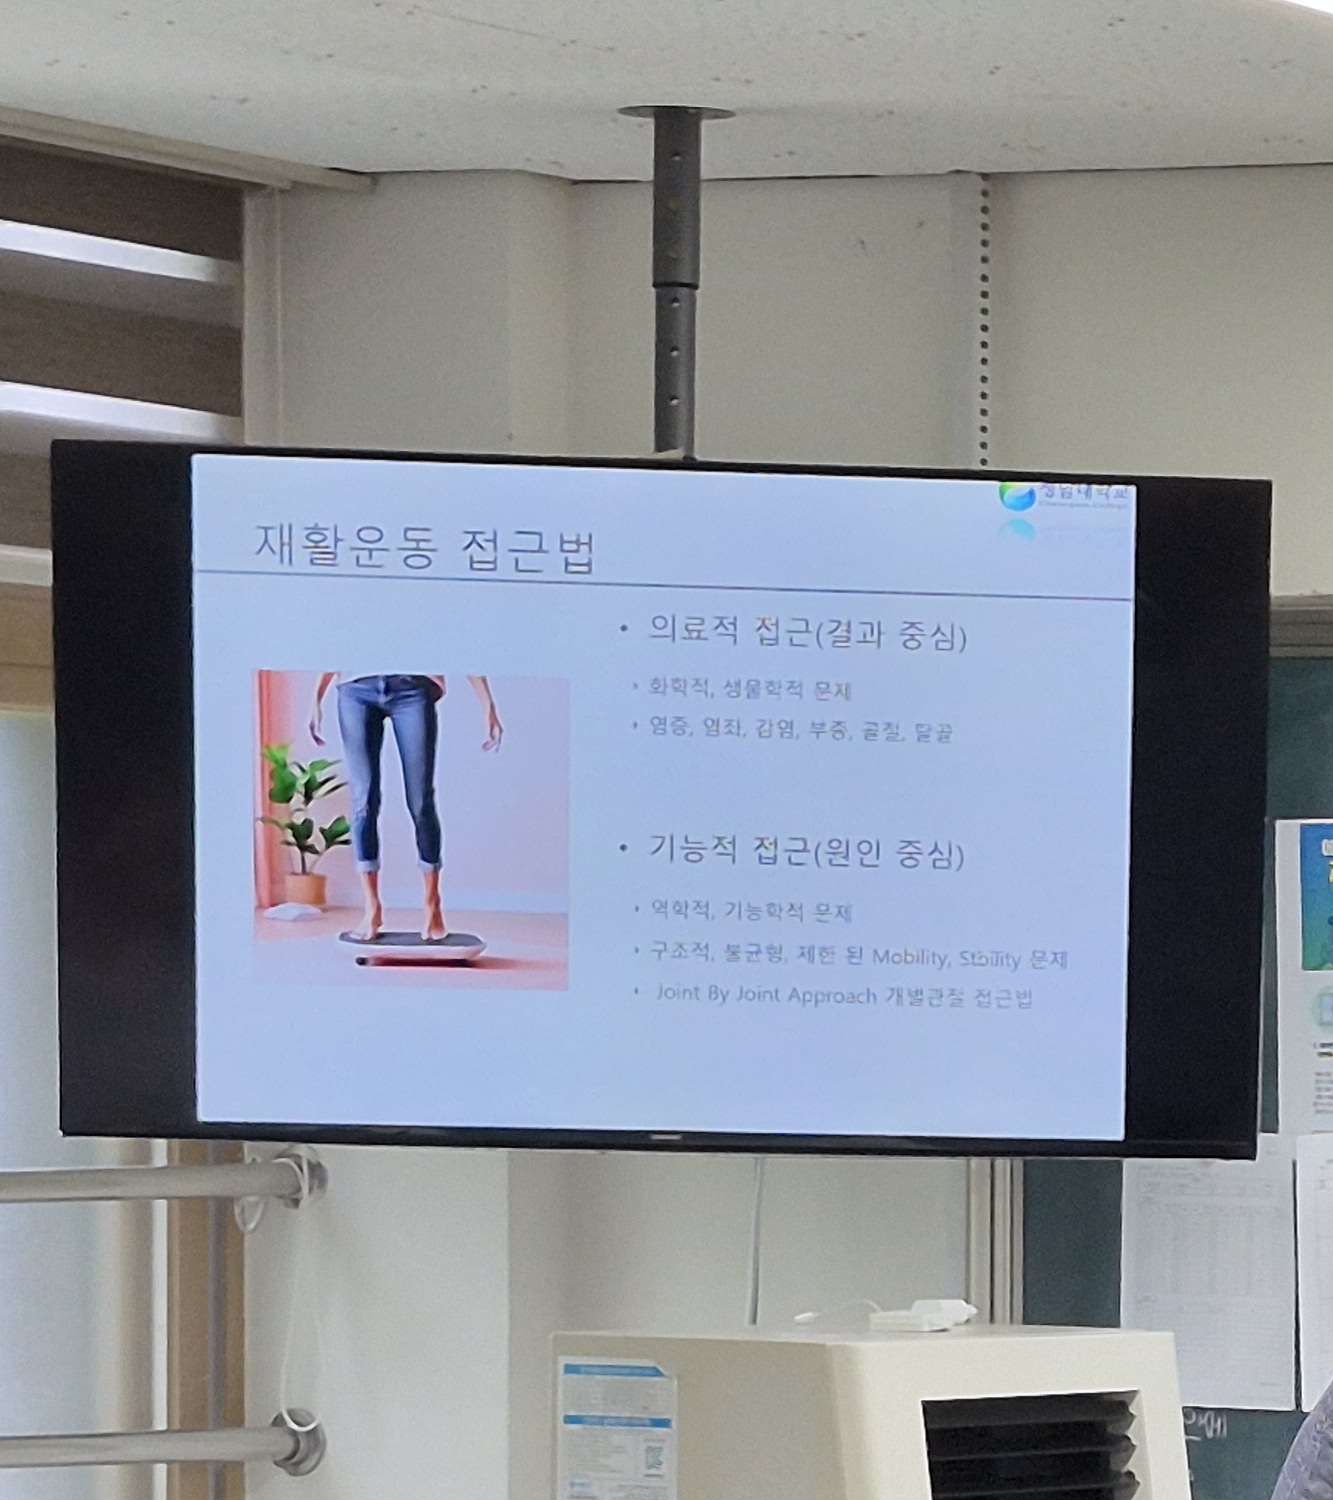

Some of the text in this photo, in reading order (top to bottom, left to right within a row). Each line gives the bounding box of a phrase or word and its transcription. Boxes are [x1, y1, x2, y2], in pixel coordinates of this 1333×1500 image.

[254, 522, 597, 575] 재활운동 접근법
[650, 613, 967, 653] 의료적 접근(결과 중심)
[649, 677, 714, 699] 화학적,
[814, 681, 852, 701] 문제
[650, 834, 965, 871] 기능적 접근(원인 중심)
[651, 900, 852, 924] 역학적, 기능학적 문제
[650, 942, 715, 963] 구조적,
[797, 945, 836, 965] 제한
[846, 946, 864, 966] 된
[874, 948, 950, 970] Mobility,
[1030, 950, 1068, 971] 문제
[656, 984, 701, 1002] Joint
[708, 985, 729, 1006] By
[736, 986, 780, 1004] Joint
[788, 987, 876, 1006] Approach
